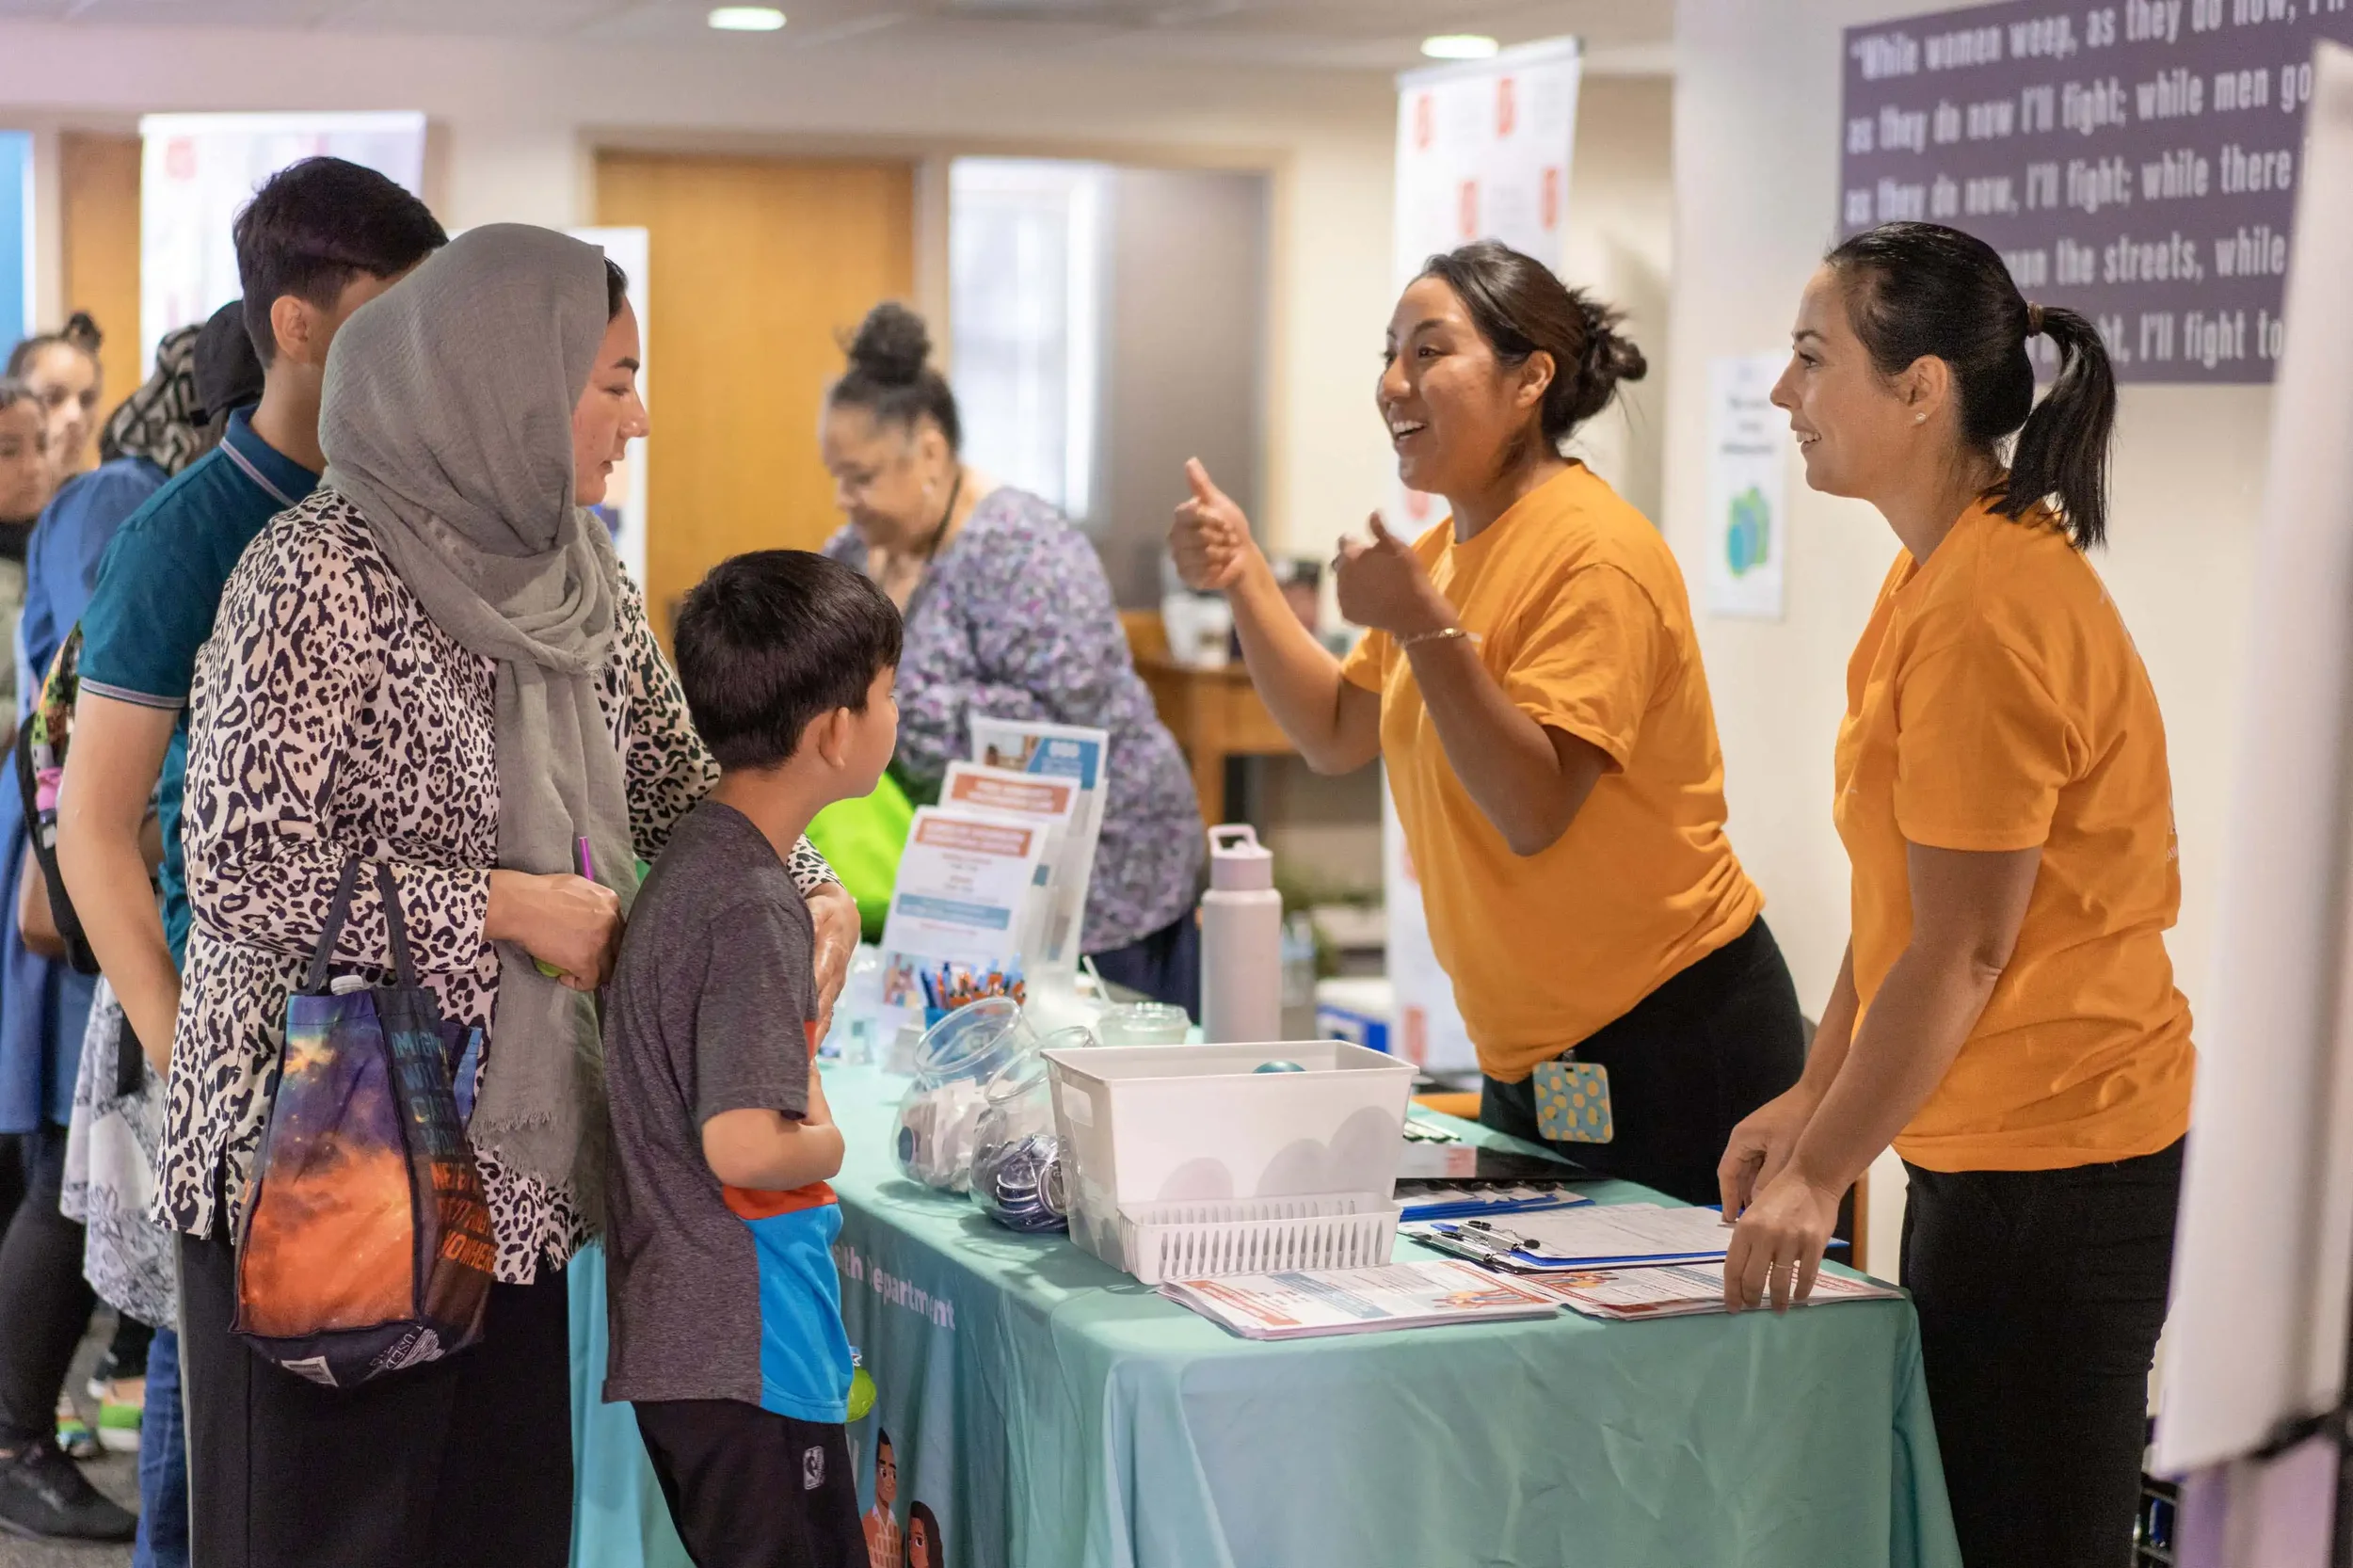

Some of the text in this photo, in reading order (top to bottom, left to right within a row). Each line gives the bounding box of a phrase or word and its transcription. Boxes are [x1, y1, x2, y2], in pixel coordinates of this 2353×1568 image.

[1925, 26, 2003, 71] women
[2087, 8, 2116, 47] as
[2125, 0, 2182, 44] they
[2191, 0, 2223, 32] do
[1847, 116, 1874, 155] as
[1880, 104, 1928, 154] they
[1933, 99, 1961, 143] do
[1967, 100, 2015, 140] now
[2136, 66, 2203, 120] while
[2214, 68, 2268, 111] men
[2281, 61, 2312, 113] go
[1845, 187, 1872, 227] as
[1877, 176, 1926, 223] they
[1931, 170, 1959, 219] do
[2141, 149, 2209, 200] while
[2220, 143, 2293, 195] there
[2055, 237, 2095, 286] the
[2104, 232, 2204, 286] streets,
[2215, 226, 2286, 276] while
[2184, 309, 2247, 371] fight
[2257, 308, 2283, 360] to
